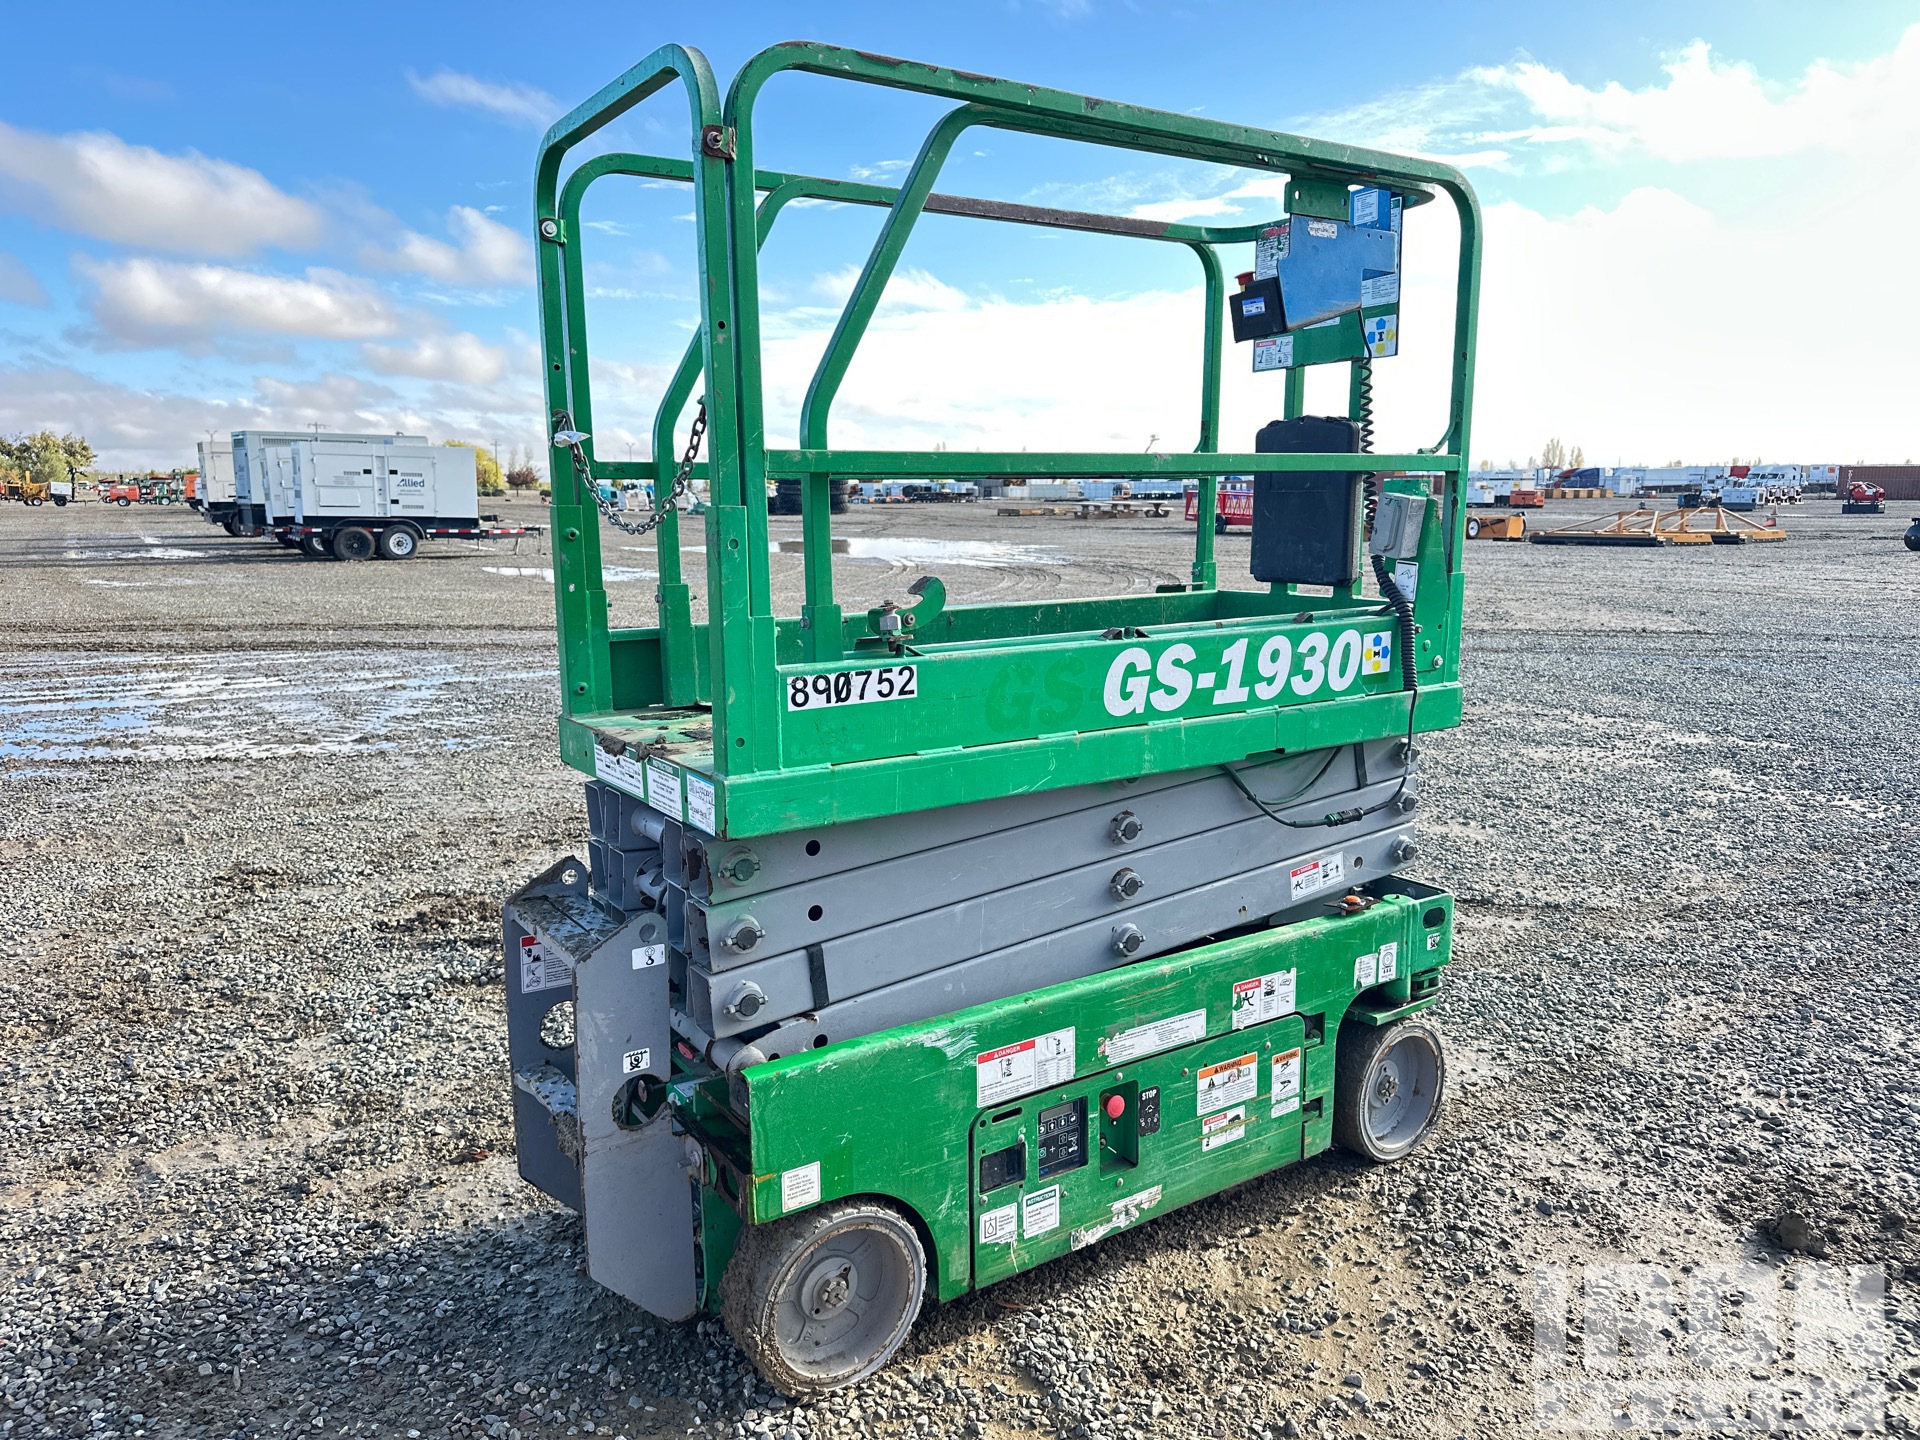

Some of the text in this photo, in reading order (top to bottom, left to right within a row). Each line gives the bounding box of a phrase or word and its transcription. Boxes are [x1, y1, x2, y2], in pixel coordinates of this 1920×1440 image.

[397, 478, 425, 488] Allied
[1103, 629, 1363, 717] GS-1930
[790, 665, 916, 709] 890752
[1241, 981, 1260, 991] DANGER
[998, 1045, 1021, 1057] DANGER
[1220, 1059, 1242, 1072] WARNING
[1142, 1089, 1157, 1101] STOP
[1027, 1190, 1056, 1205] INSTRUCTIONS
